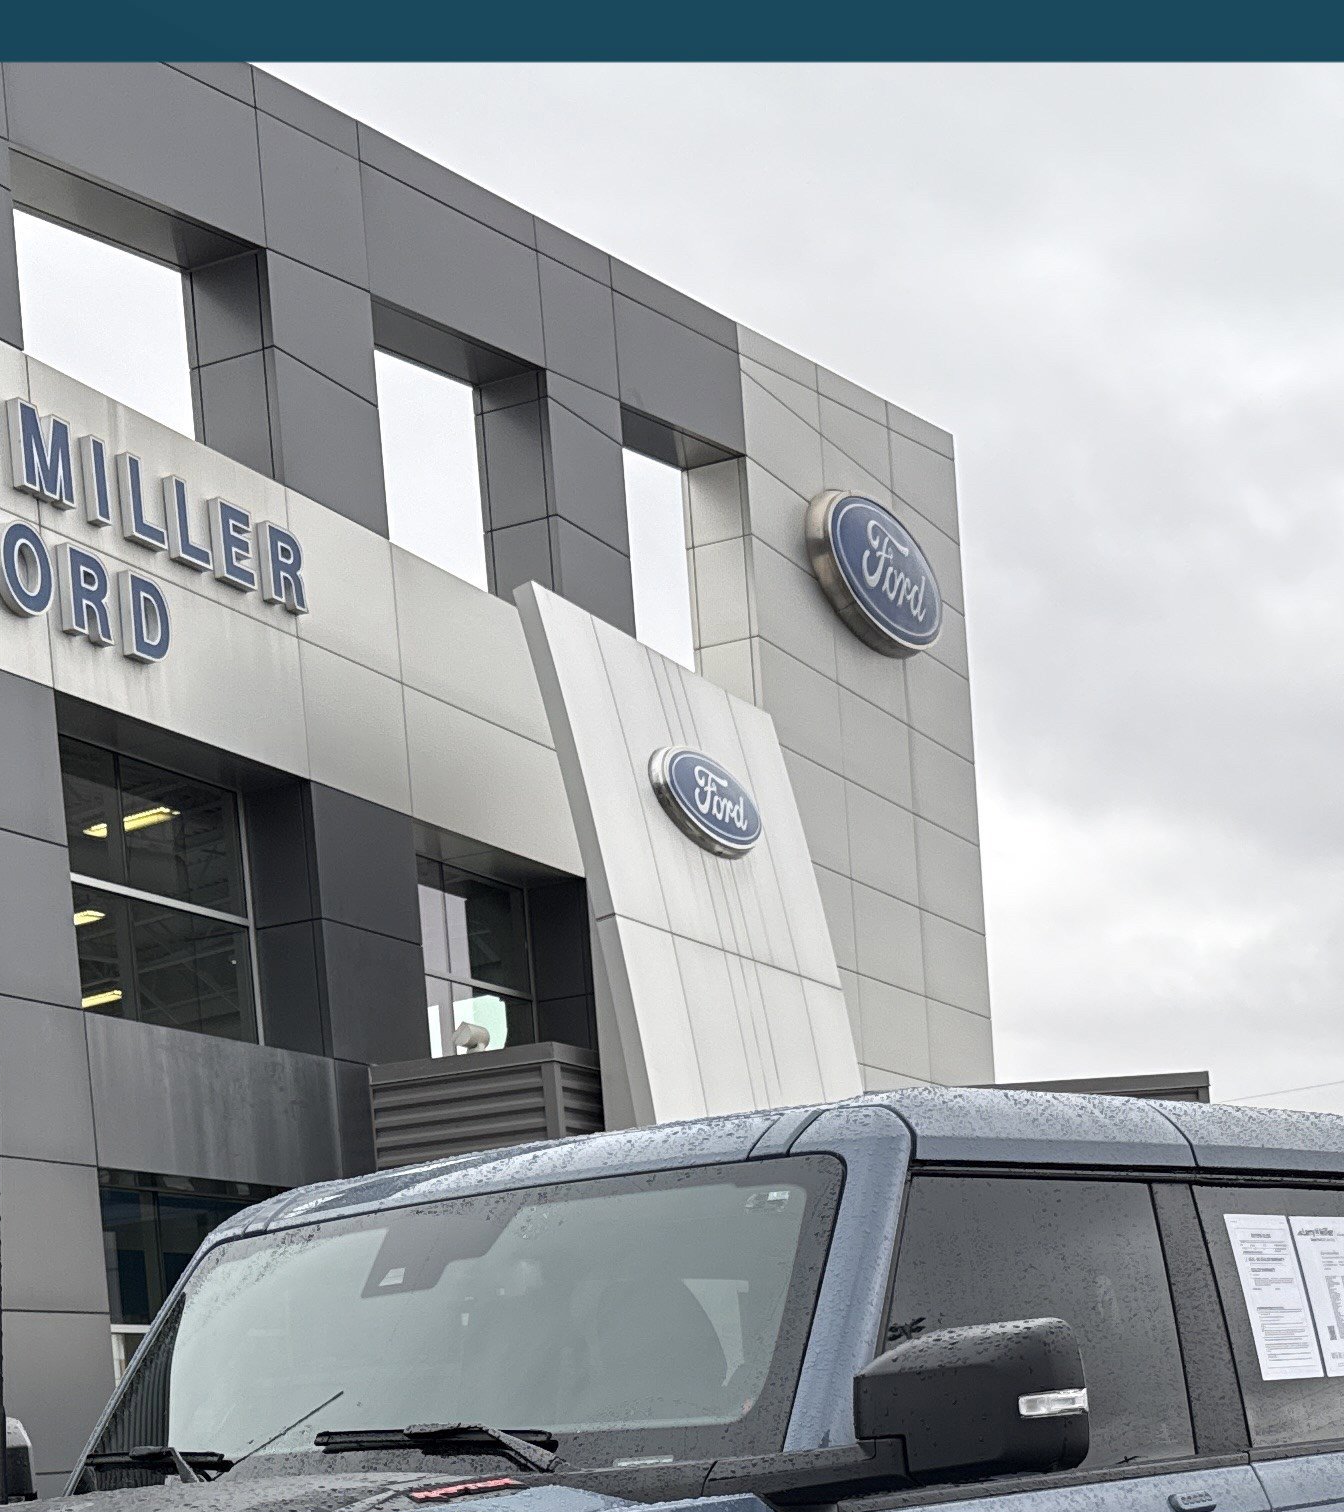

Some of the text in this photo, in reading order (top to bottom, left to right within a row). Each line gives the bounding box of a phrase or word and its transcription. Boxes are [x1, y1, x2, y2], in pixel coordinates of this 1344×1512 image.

[7, 397, 309, 615] MILLER
[861, 518, 927, 624] Ford
[693, 764, 748, 832] Ford
